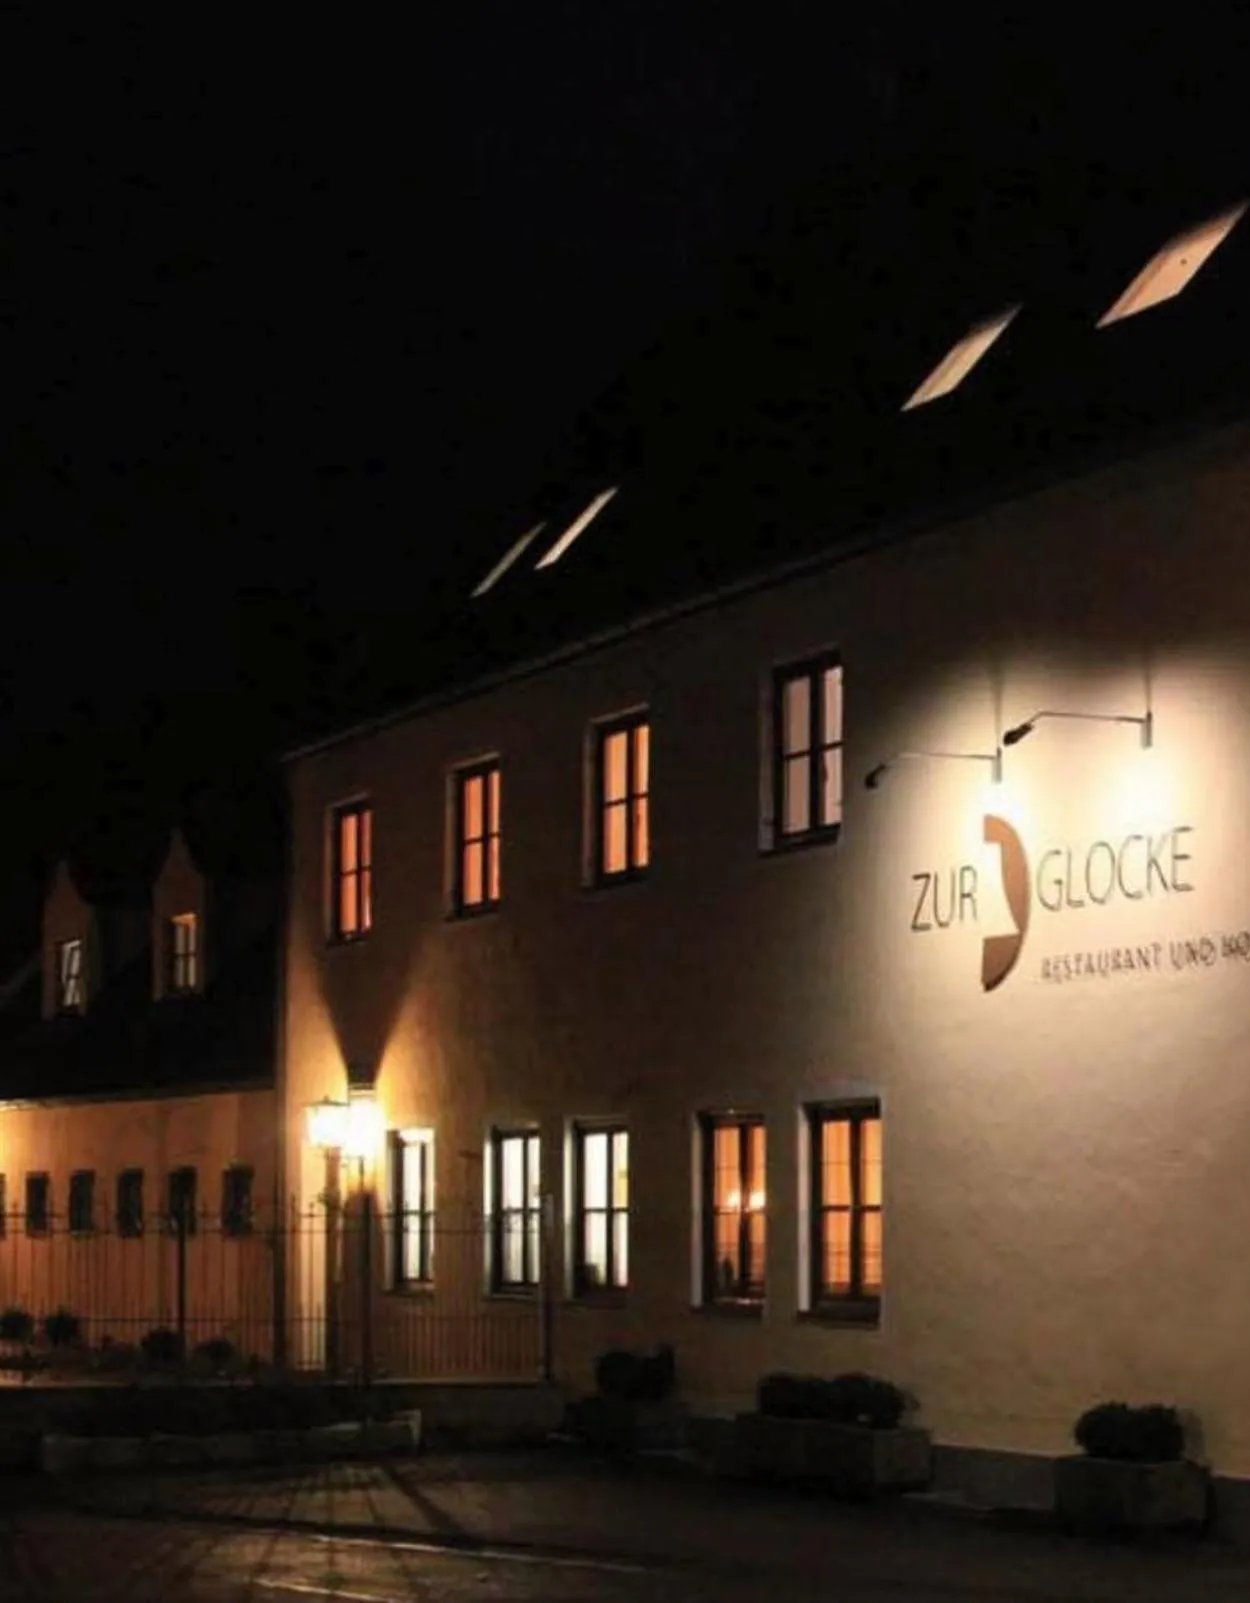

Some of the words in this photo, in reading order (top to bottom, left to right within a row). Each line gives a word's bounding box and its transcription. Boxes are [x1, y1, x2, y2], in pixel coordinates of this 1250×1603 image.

[911, 865, 979, 932] ZUR
[1036, 826, 1195, 911] GLOCKE
[1041, 942, 1162, 980] RESTAURANT
[1168, 937, 1215, 970] UND
